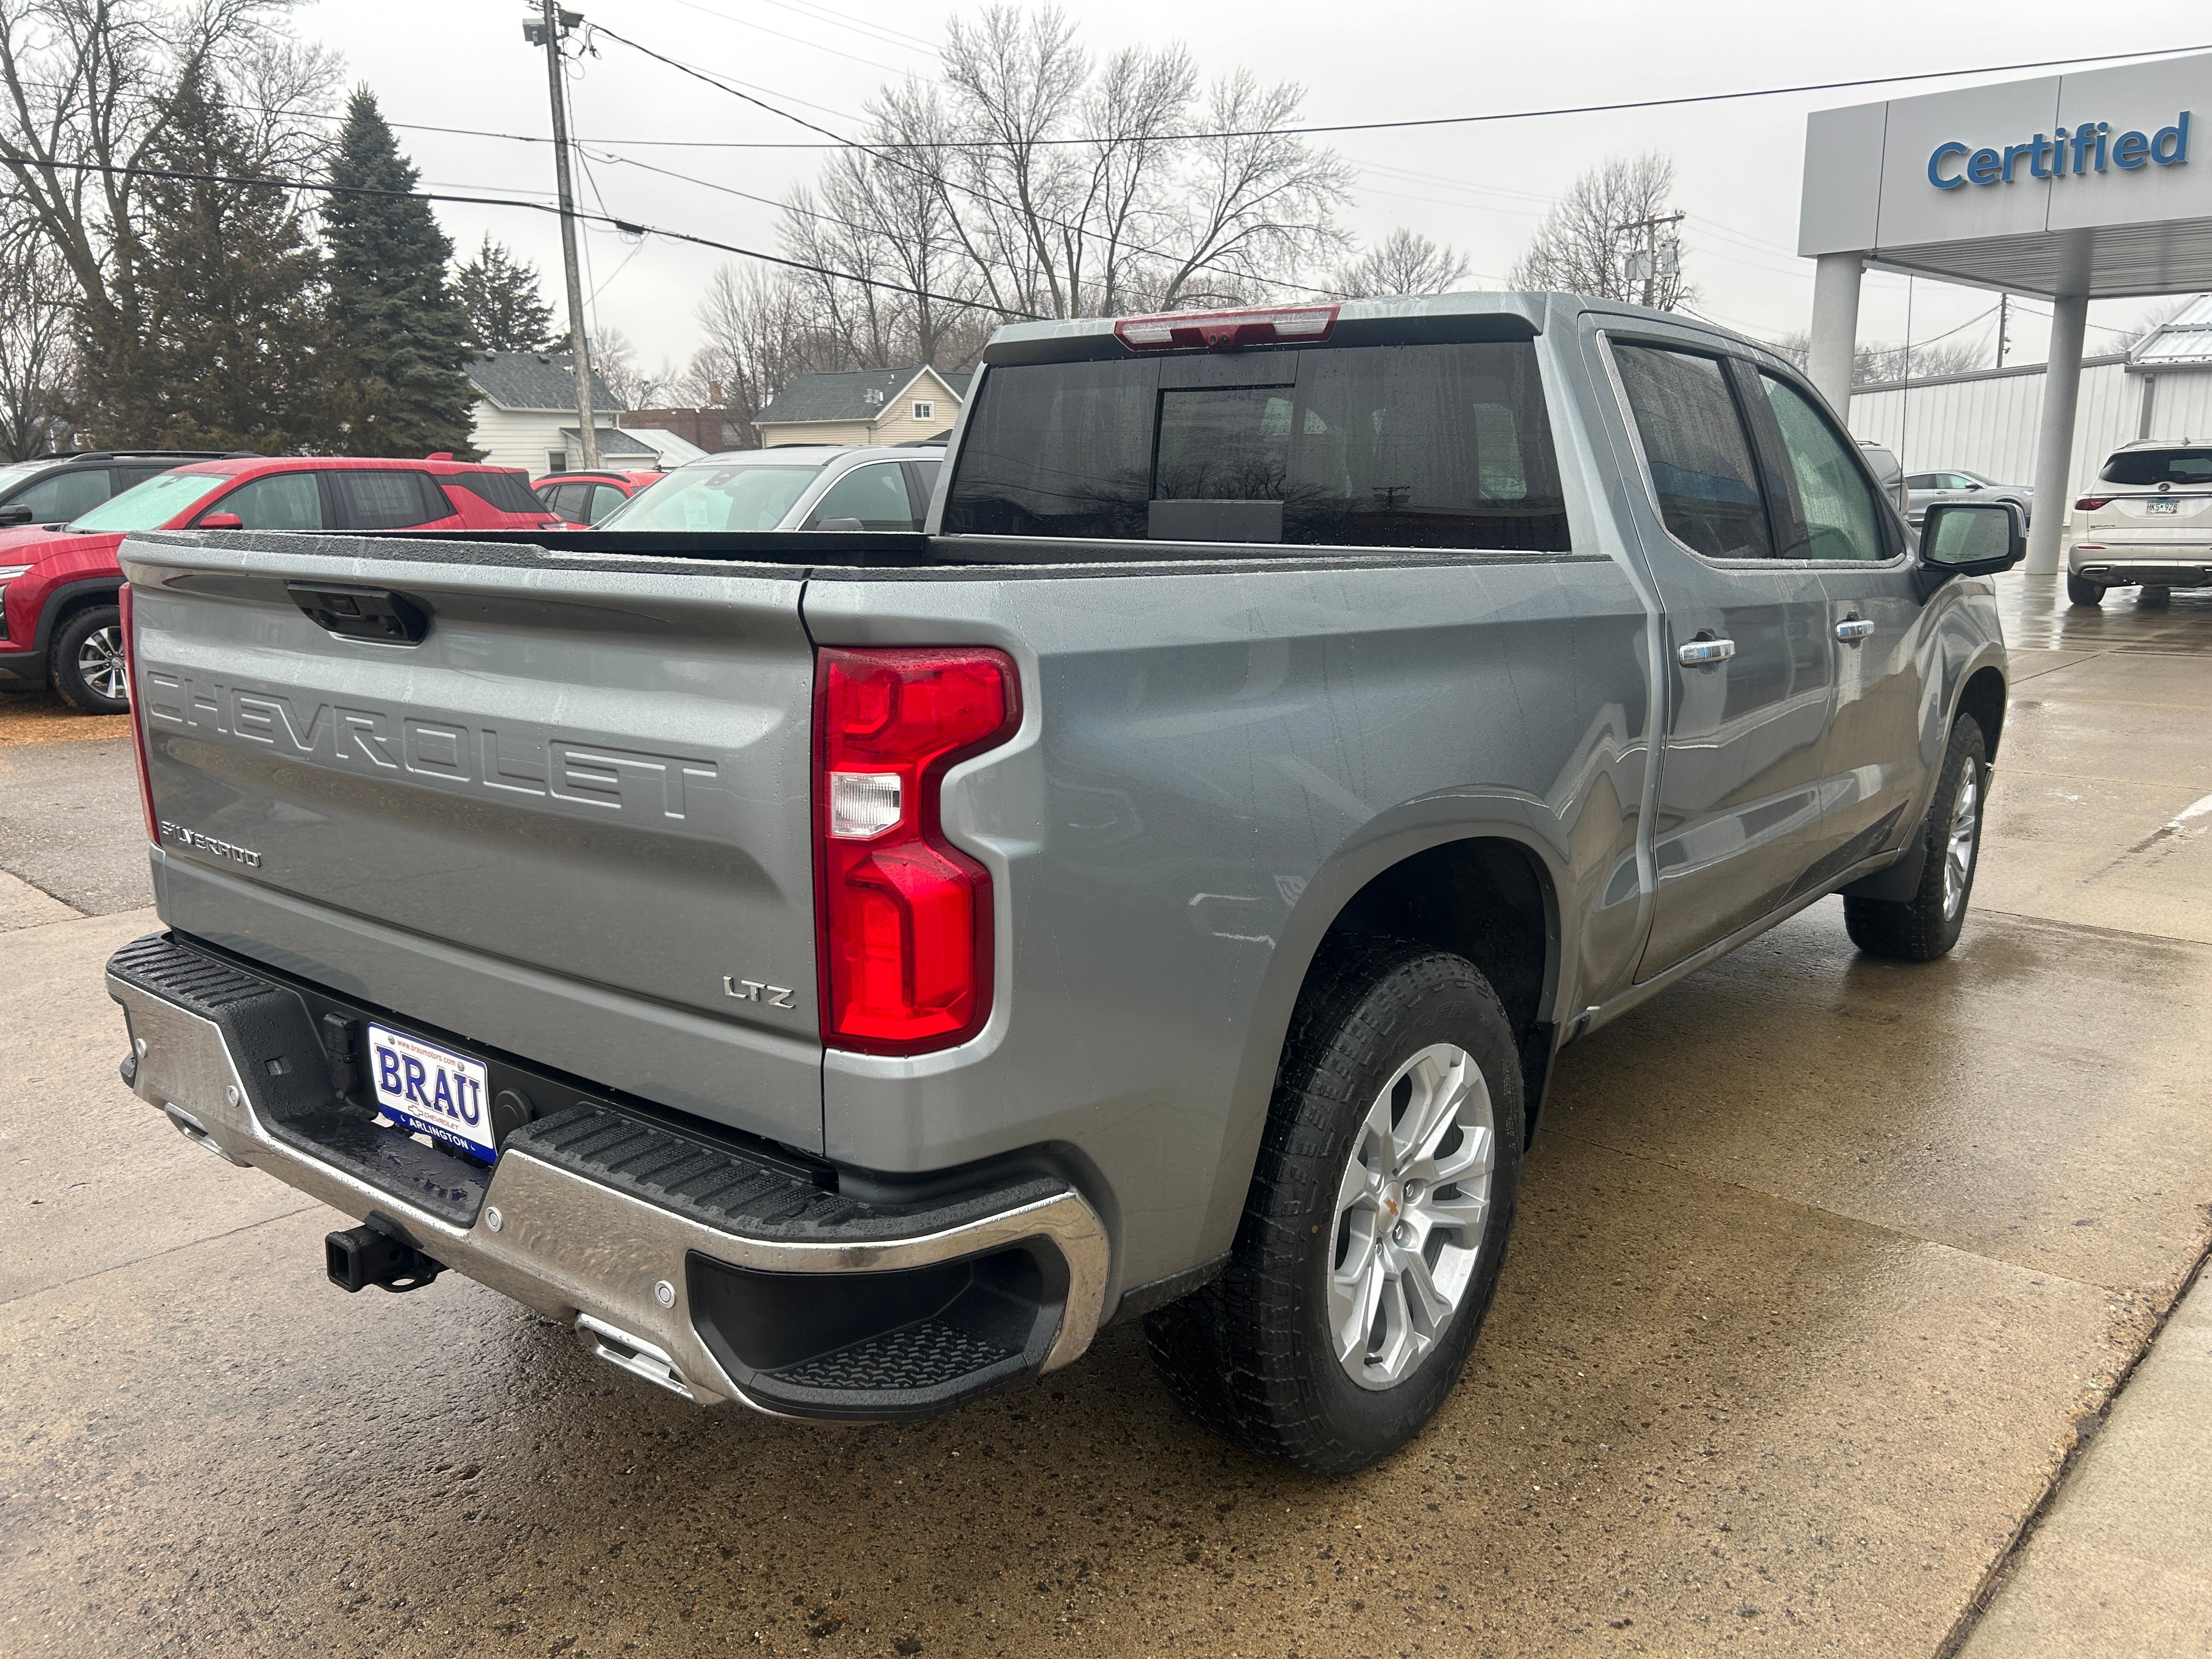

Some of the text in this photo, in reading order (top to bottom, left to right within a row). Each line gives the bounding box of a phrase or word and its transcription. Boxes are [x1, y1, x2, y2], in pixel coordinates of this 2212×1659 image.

[1927, 110, 2191, 189] Certified
[148, 670, 718, 819] CHEVROLET
[161, 821, 262, 867] SILVERADO
[723, 975, 795, 1009] LTZ
[397, 1039, 456, 1066] www.braumotors.com
[374, 1043, 481, 1128] BRAU
[409, 1118, 469, 1150] ARLINGTON
[424, 1112, 459, 1130] CHEVROLET
